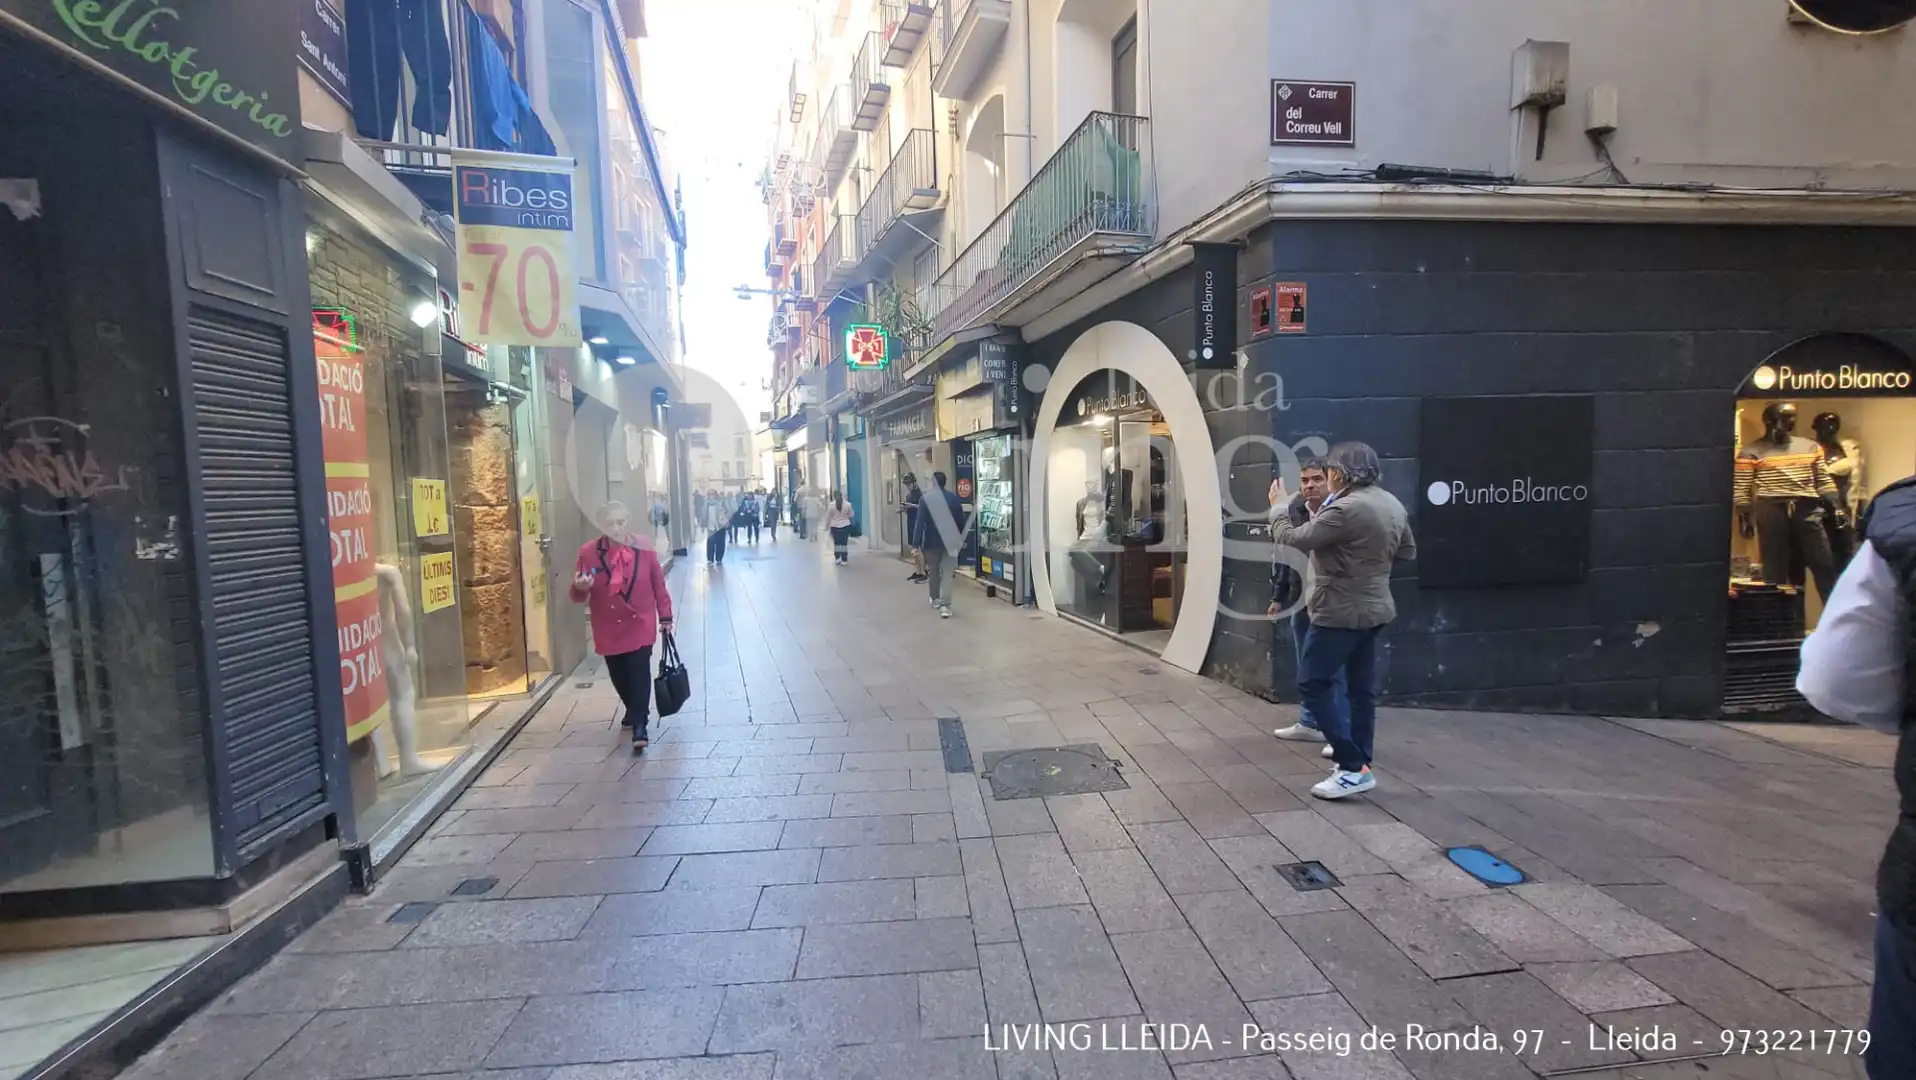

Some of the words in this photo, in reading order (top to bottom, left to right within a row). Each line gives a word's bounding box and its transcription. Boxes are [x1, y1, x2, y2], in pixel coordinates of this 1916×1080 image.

[1308, 87, 1338, 99] Carrer
[1286, 106, 1302, 120] del
[1286, 120, 1321, 134] Correu
[1323, 121, 1342, 135] Vell
[461, 169, 568, 210] Ribes
[517, 211, 569, 228] intim
[1201, 270, 1214, 312] Blanco
[1202, 313, 1214, 346] Punto
[1780, 365, 1837, 390] Punto
[1839, 363, 1911, 389] Blanco
[1086, 396, 1110, 415] Punto
[1111, 387, 1147, 410] Blanco
[1452, 480, 1510, 505] Punto
[1512, 476, 1588, 503] Blanco
